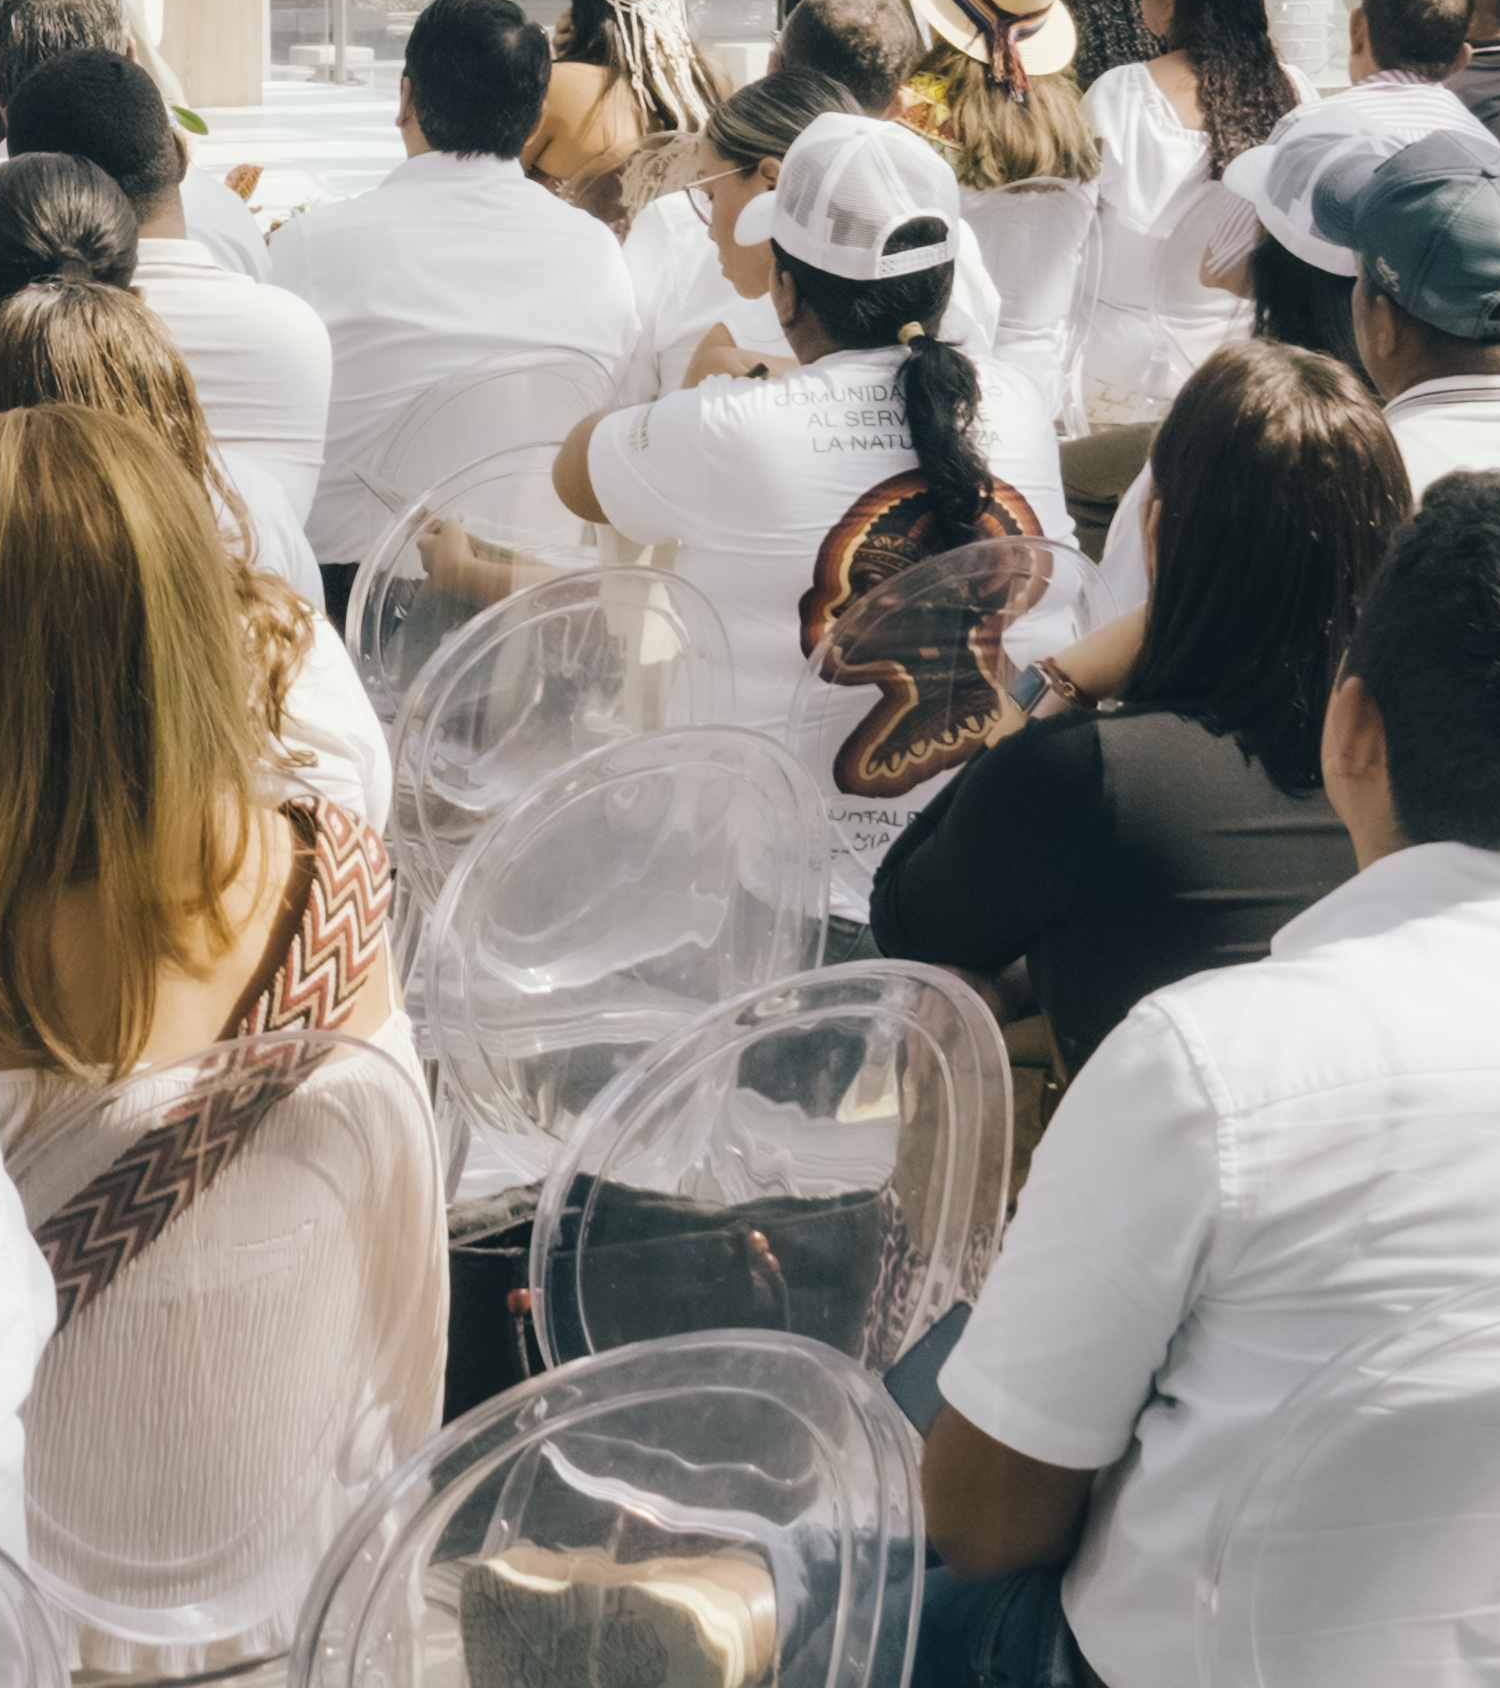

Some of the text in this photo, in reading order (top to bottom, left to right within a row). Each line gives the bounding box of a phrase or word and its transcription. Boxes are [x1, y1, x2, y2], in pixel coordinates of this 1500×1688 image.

[775, 384, 907, 406] COMUNIDA
[807, 412, 837, 428] AL
[845, 409, 908, 427] SERV
[812, 436, 844, 453] LA
